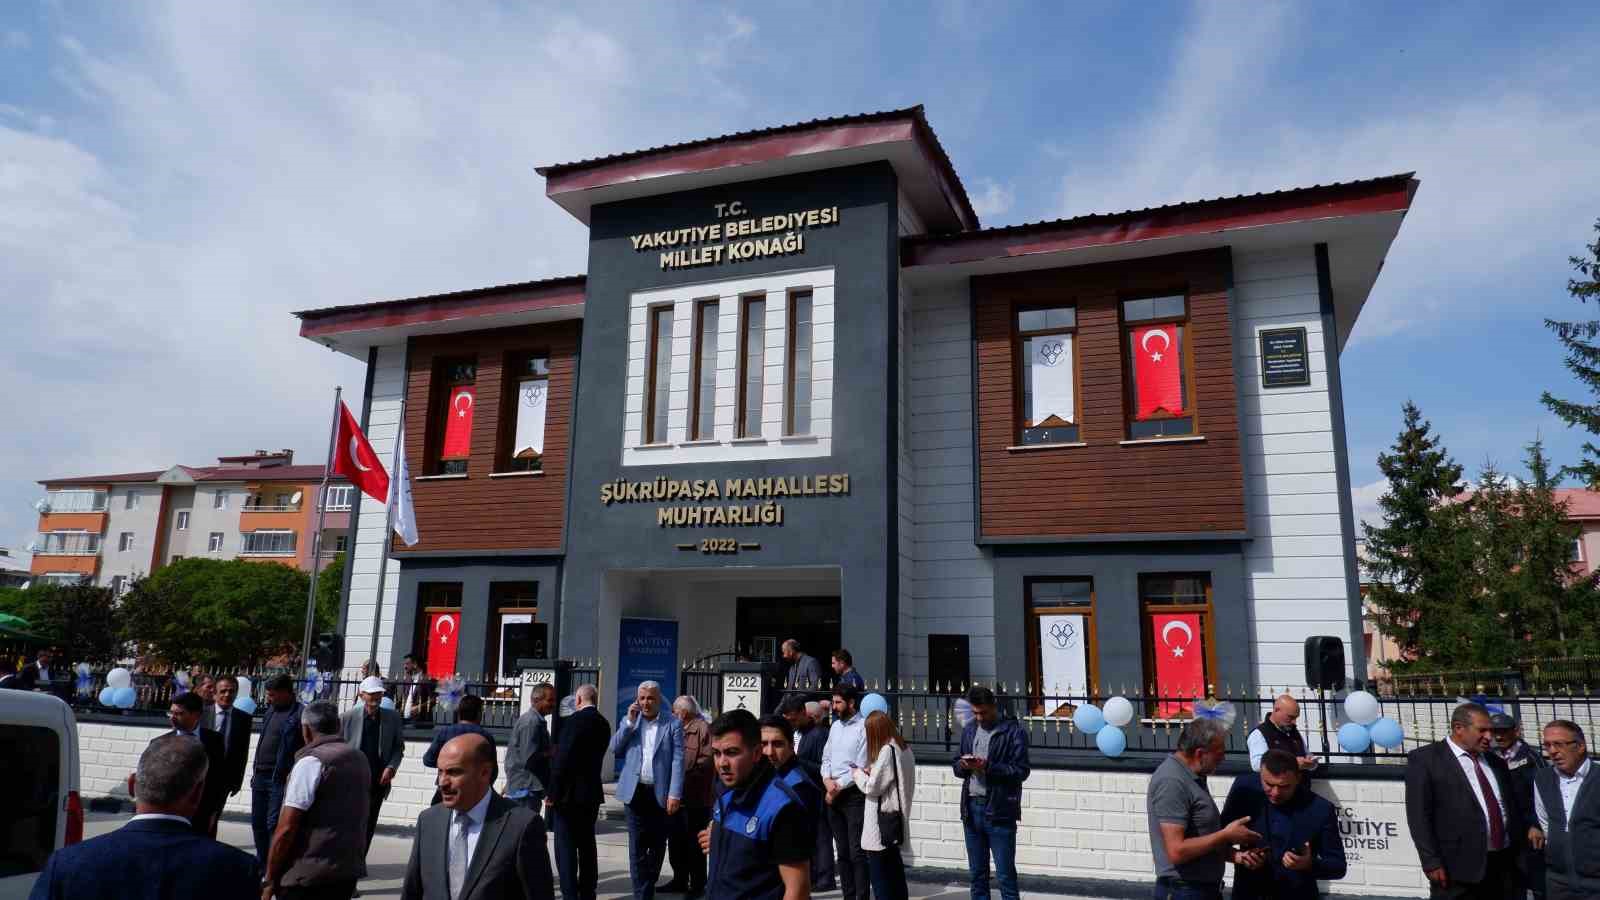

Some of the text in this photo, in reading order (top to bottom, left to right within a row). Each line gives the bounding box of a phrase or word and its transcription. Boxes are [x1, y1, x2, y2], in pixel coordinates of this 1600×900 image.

[714, 201, 748, 218] T.C.
[630, 206, 839, 249] YAKUTİYE BELEDİYESİ
[660, 231, 803, 268] MİLLET KONAĞI
[600, 474, 849, 504] ŞÜKRÜPAŞA MAHALLESİ
[657, 501, 783, 525] MUHTARLIĞI
[701, 538, 736, 552] 2022
[526, 672, 551, 682] 2022
[728, 676, 757, 688] 2022
[1338, 818, 1398, 836] UTİYE
[1344, 836, 1388, 849] DİYESİ
